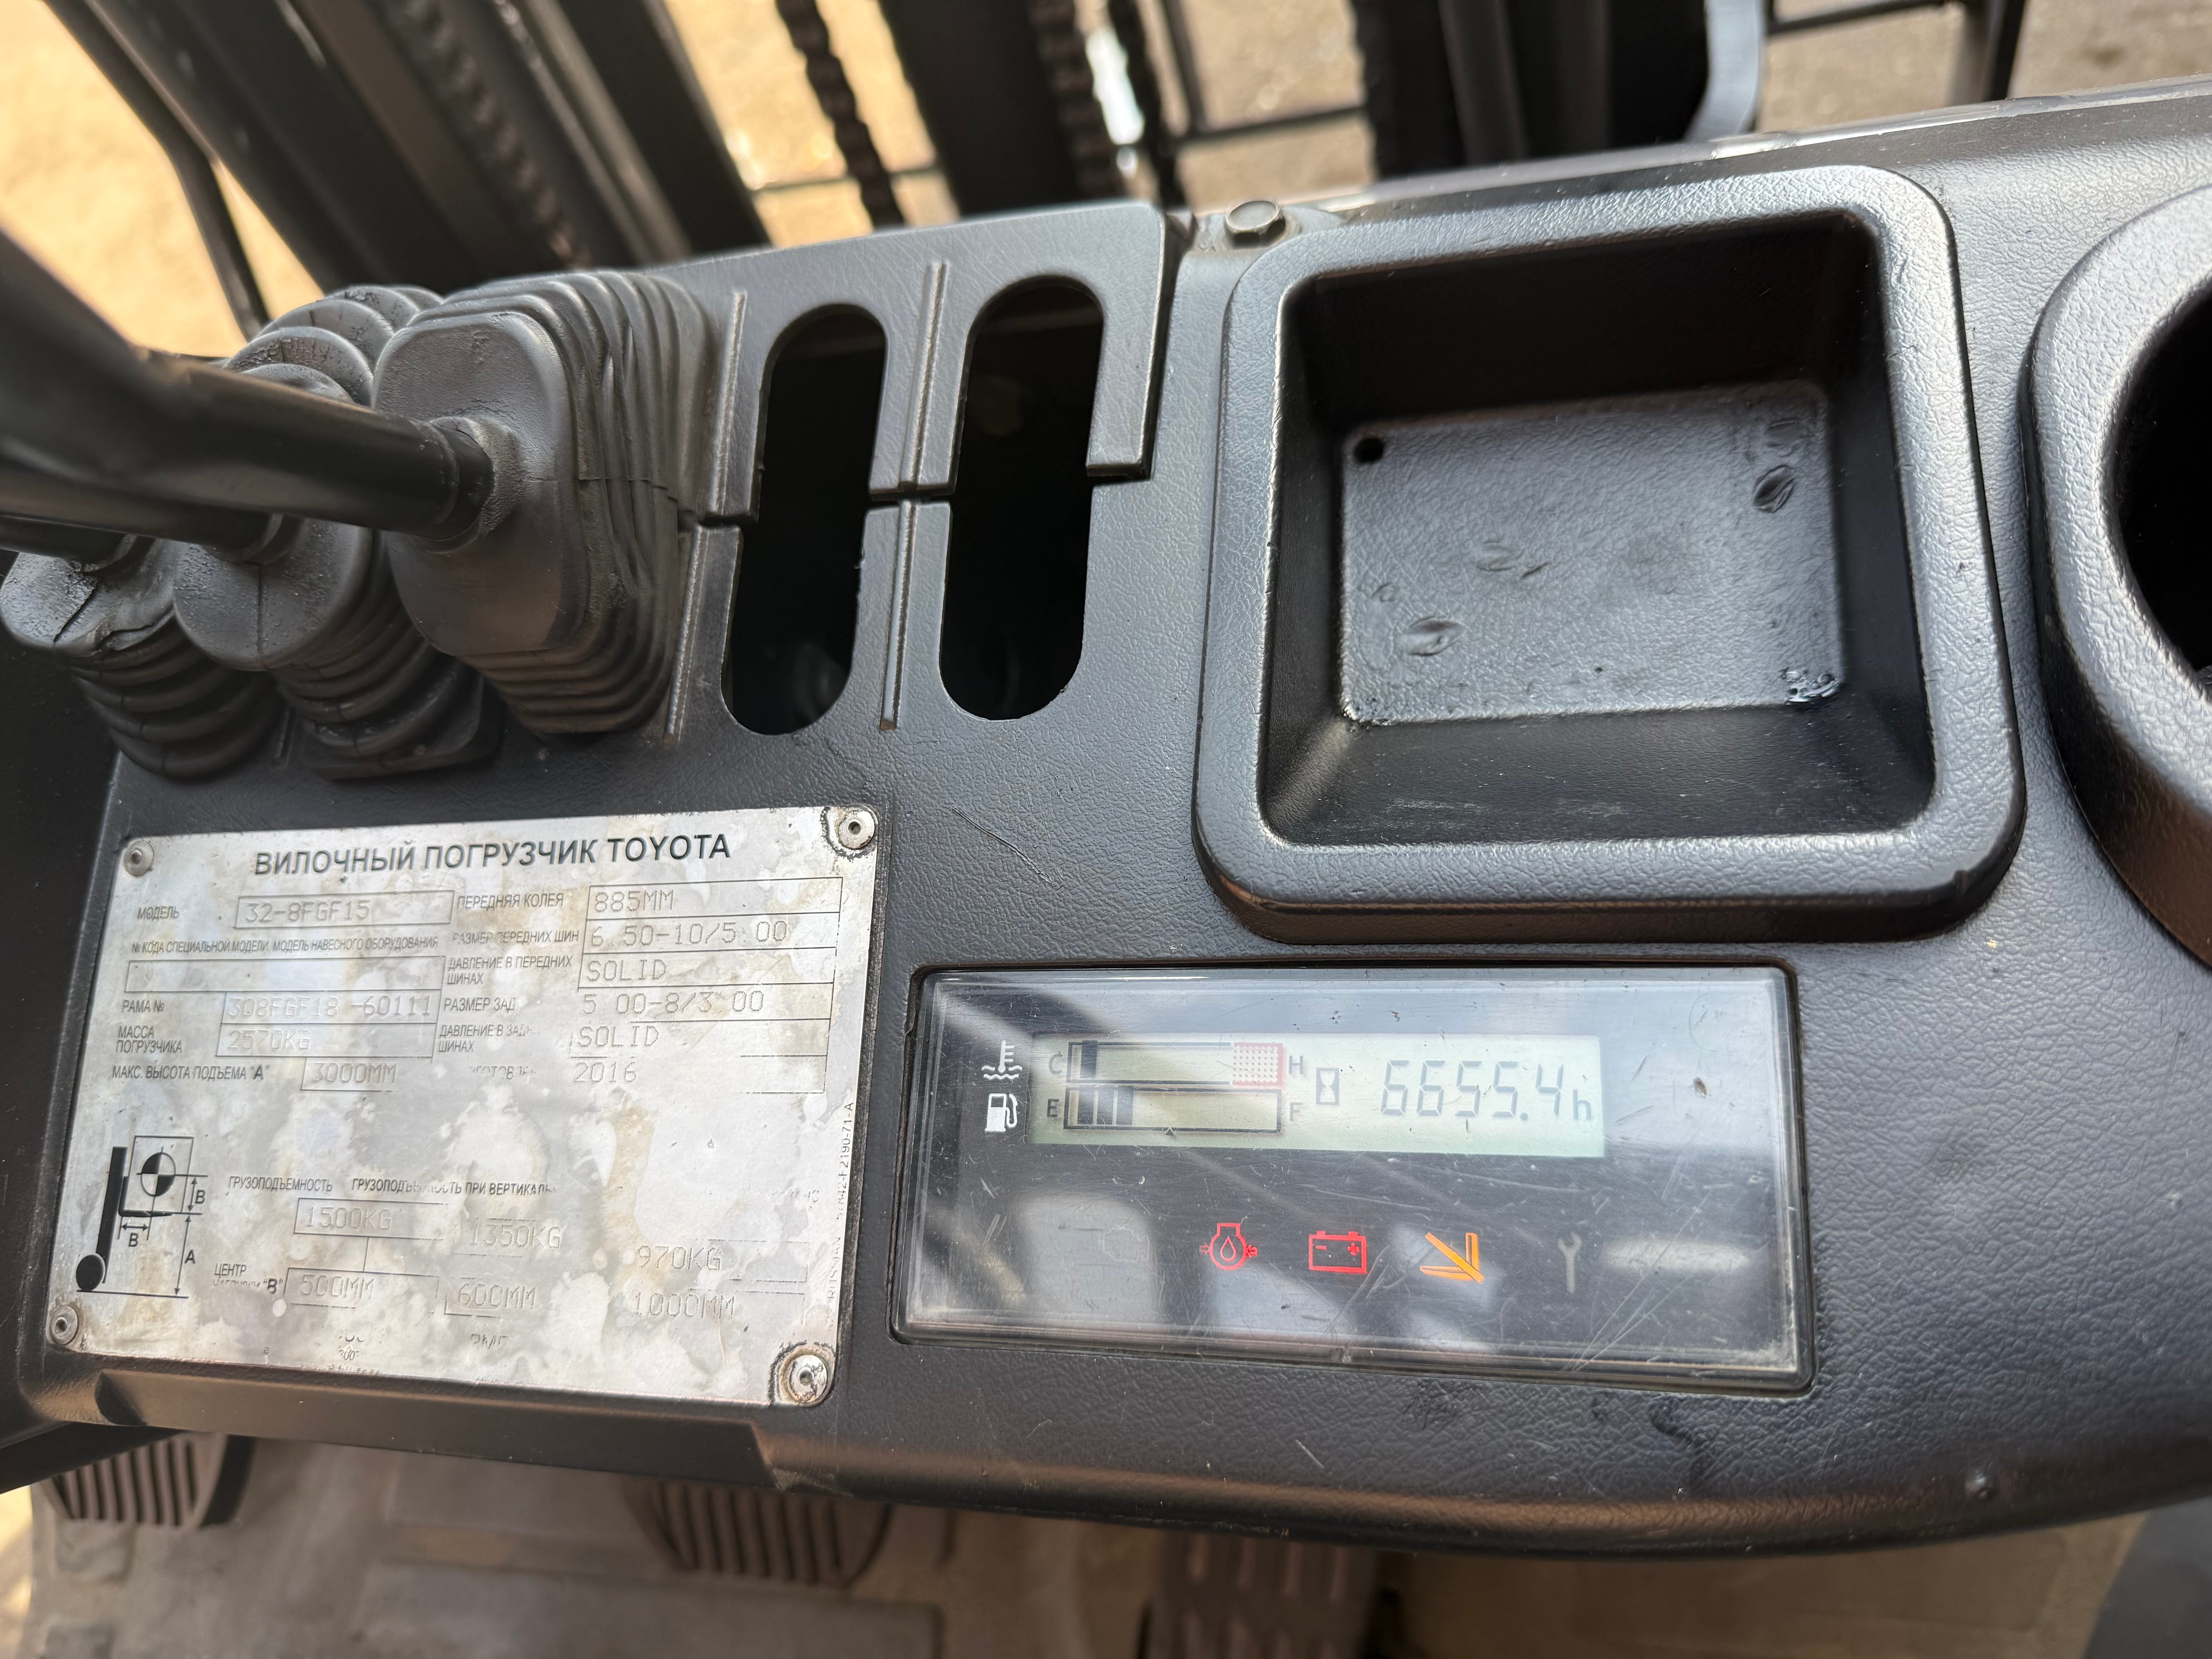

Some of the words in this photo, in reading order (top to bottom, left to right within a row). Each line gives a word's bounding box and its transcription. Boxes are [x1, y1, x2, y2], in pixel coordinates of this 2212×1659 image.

[255, 840, 414, 875] ВИЛОЧНЫЙ
[424, 838, 599, 869] ПОГРУЗЧИК
[607, 834, 731, 862] TOYOTA
[457, 894, 522, 911] ПЕРЕДНЯЯ
[524, 893, 564, 907] КОЛЕЯ
[595, 890, 674, 912] 885MM
[137, 905, 180, 920] МОДЕЛЬ
[245, 901, 371, 923] 32-8FGF15
[142, 941, 164, 954] КОДА
[167, 939, 230, 954] СПЕЦИАЛЬНОЙ
[273, 939, 309, 953] МОДЕЛЬ
[311, 938, 364, 951] НАВЕСНОГО
[366, 936, 438, 951] ОБОРУДОВАНИЯ
[555, 929, 579, 942] ШИН
[448, 957, 503, 971] ДАВЛЕНИЕ
[515, 956, 573, 969] ПЕРЕДНИХ
[587, 959, 666, 981] SOLID
[447, 972, 484, 984] ШИНАХ
[122, 1000, 150, 1013] РАМА
[154, 1000, 165, 1013] №
[443, 998, 490, 1011] РАЗМЕР
[118, 1025, 154, 1038] МАССА
[440, 1025, 494, 1039] ДАВЛЕНИЕ
[579, 1025, 659, 1047] SOLID
[116, 1040, 182, 1053] ПОГРУЗЧИКА
[439, 1041, 475, 1052] ШИНАХ
[112, 1065, 143, 1079] МАКС.
[146, 1065, 190, 1079] ВЫСОТА
[194, 1066, 247, 1081] ПОДЪЕМА
[312, 1062, 397, 1084] 3000MM
[574, 1061, 637, 1082] 2016
[1048, 1053, 1063, 1075] C
[1288, 1055, 1304, 1075] H
[1047, 1098, 1060, 1118] E
[1289, 1102, 1303, 1121] F
[228, 1176, 333, 1192] ГРУЗОПОДЪЕМНОСТЬ
[465, 1182, 486, 1195] ПРИ
[307, 1206, 392, 1230] 1500KG
[469, 1223, 562, 1249] 1350KG
[637, 1245, 721, 1271] 970KG
[214, 1263, 247, 1280] ЦЕНТР
[301, 1274, 375, 1300] 500MM
[459, 1283, 536, 1309] 600MM
[633, 1292, 735, 1319] 1000MM
